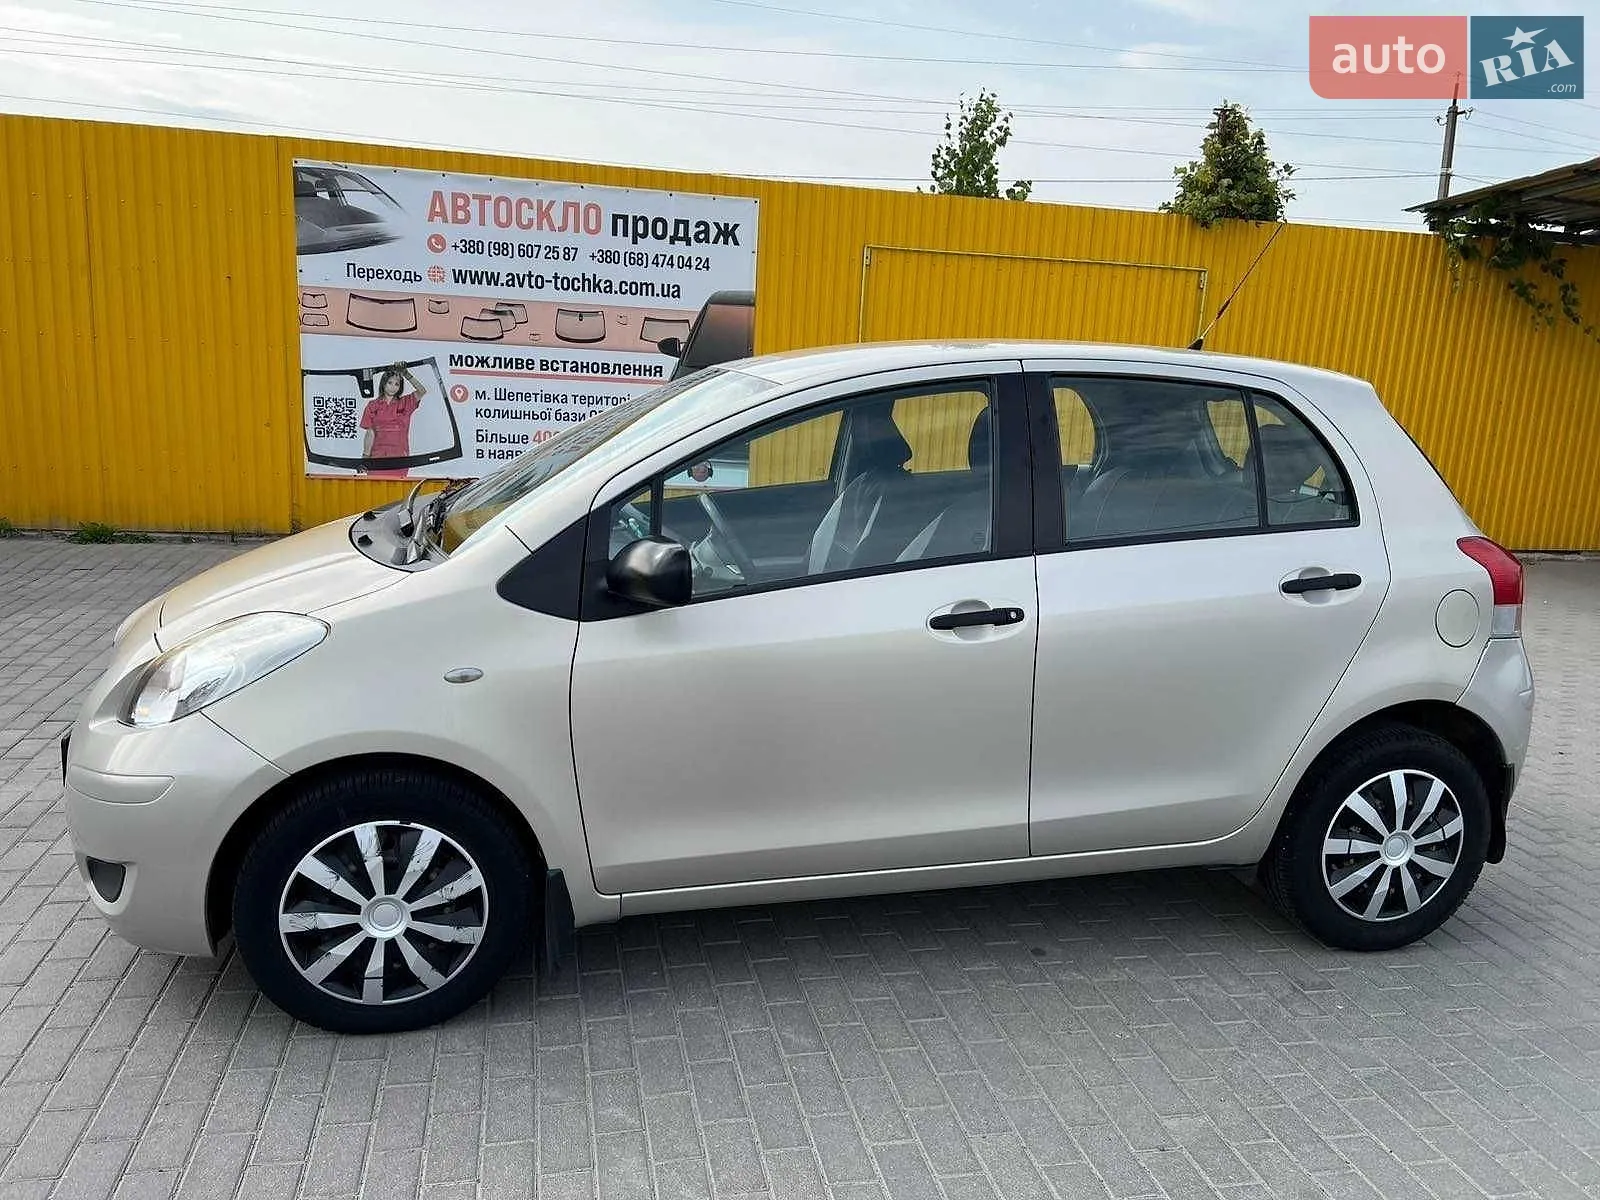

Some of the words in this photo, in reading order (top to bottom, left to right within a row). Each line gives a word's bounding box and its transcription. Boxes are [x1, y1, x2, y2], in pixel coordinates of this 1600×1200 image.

[427, 190, 602, 236] АВТОСКЛО
[611, 212, 740, 247] продаж
[452, 239, 484, 255] +380
[488, 241, 515, 259] (98)
[518, 243, 542, 259] 607
[544, 245, 561, 261] 25
[562, 246, 578, 262] 87
[589, 249, 621, 266] +380
[623, 252, 649, 269] (68)
[651, 253, 675, 269] 474
[677, 255, 693, 270] 04
[694, 256, 710, 272] 24
[346, 262, 422, 284] Переходь
[452, 268, 681, 299] www.avto-tochka.com.ua
[449, 354, 535, 371] можливе
[540, 359, 664, 378] встановлення
[475, 390, 491, 401] м.
[494, 387, 568, 404] Шепетівка
[475, 407, 552, 421] колишньої
[555, 408, 586, 422] бази
[475, 429, 529, 445] Більше
[532, 430, 560, 445] 40
[476, 448, 484, 459] в
